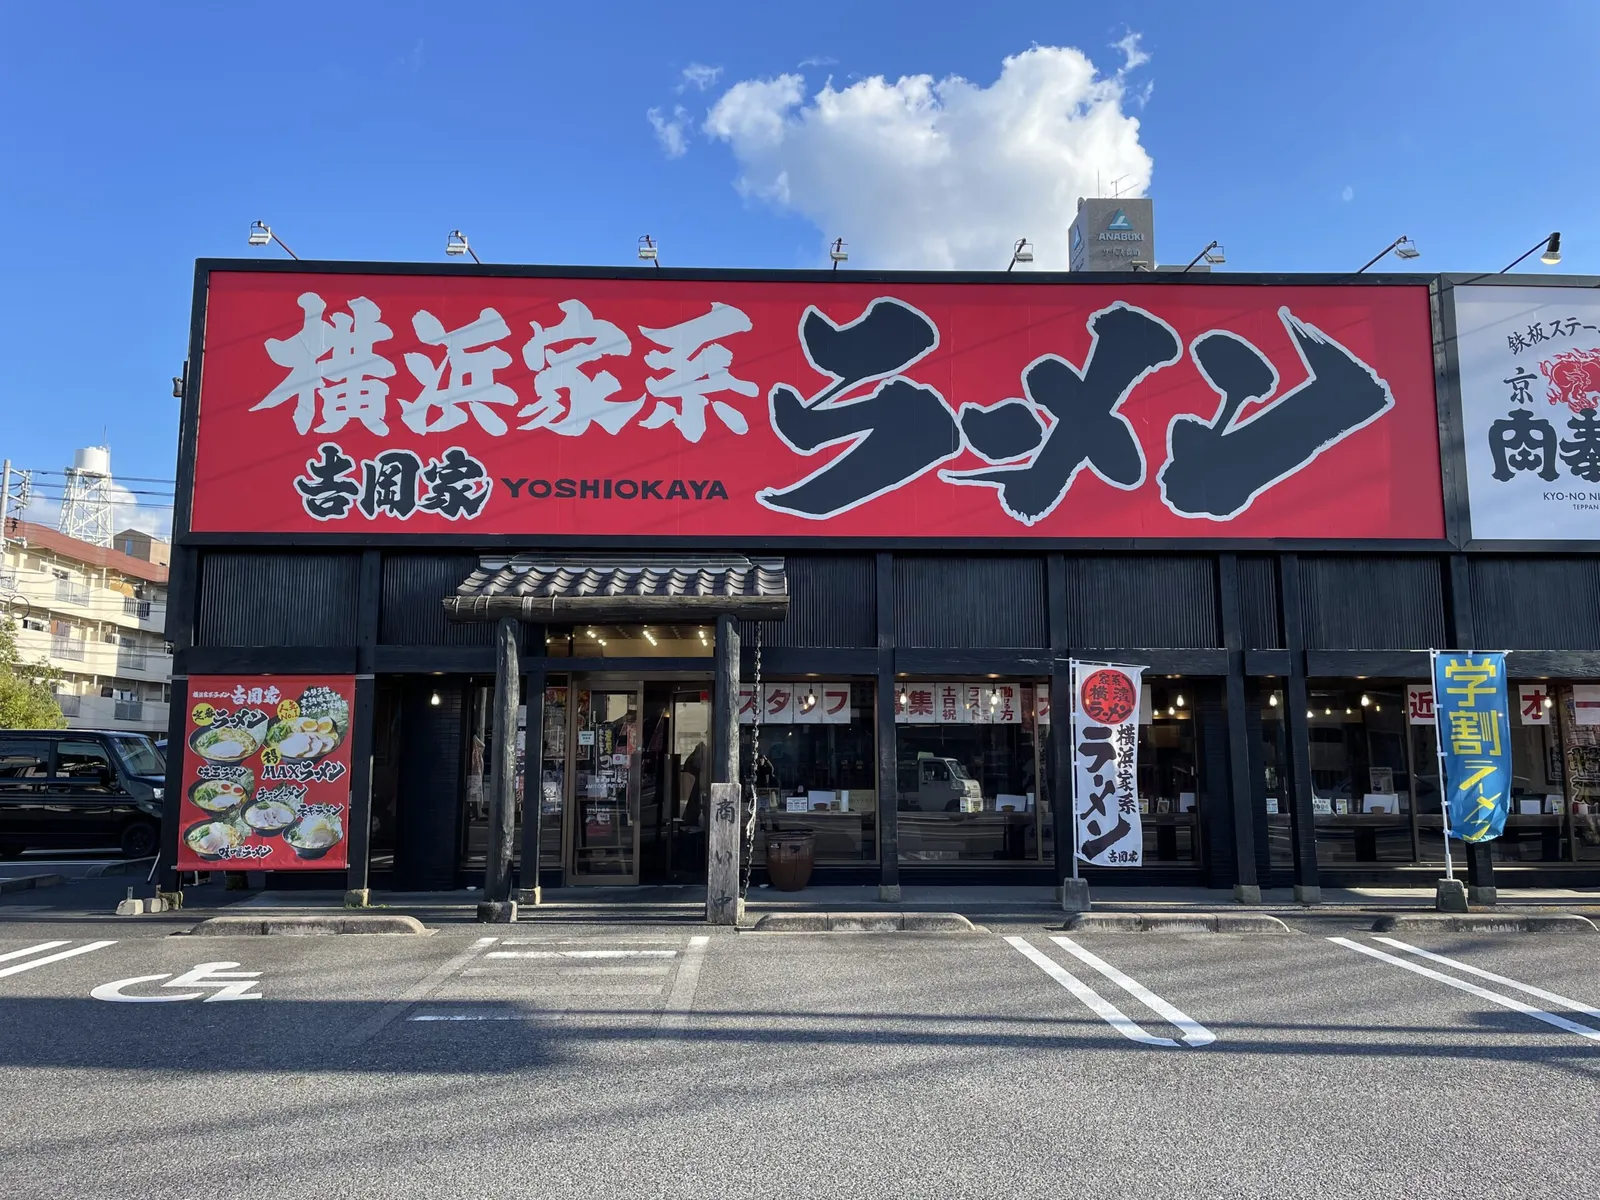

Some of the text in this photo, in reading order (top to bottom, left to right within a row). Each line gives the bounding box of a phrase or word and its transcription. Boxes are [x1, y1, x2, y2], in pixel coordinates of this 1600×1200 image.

[1098, 232, 1145, 241] ANABUKI
[1506, 316, 1600, 356] 鉄板ステー
[1502, 366, 1538, 405] 京
[248, 291, 1395, 525] 横浜家系 ラーメン
[500, 477, 729, 501] YOSHIOKAYA
[1543, 491, 1587, 501] KYO-NO
[1573, 503, 1600, 511] TEPPAN
[739, 689, 849, 716] スタッフ
[942, 686, 957, 721] 土日祝
[1089, 701, 1133, 722] ラーメン
[210, 707, 269, 730] ラーメン
[261, 760, 347, 783] MAXラーメン
[1116, 723, 1136, 815] 横浜家系
[1078, 726, 1132, 861] ラーメン
